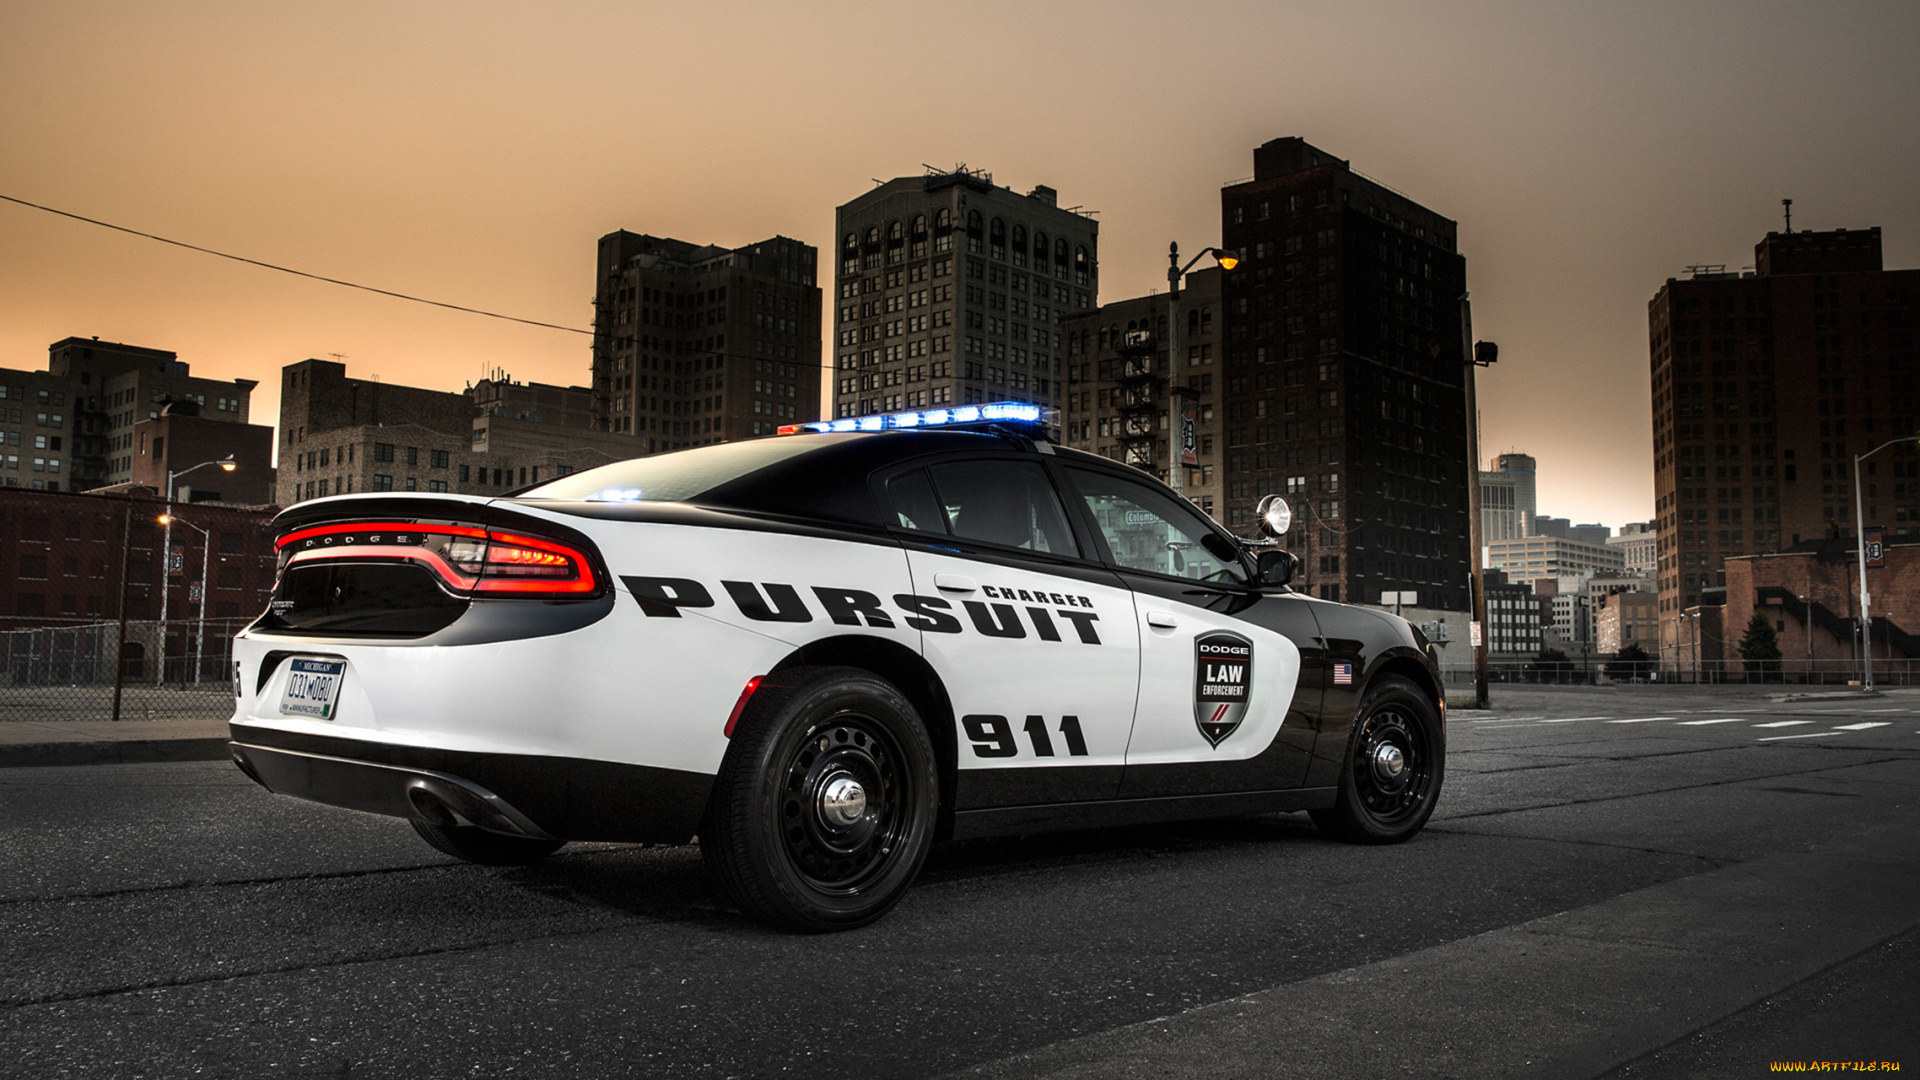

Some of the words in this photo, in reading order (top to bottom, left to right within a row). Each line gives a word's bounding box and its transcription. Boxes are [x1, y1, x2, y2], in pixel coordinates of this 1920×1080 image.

[306, 535, 408, 546] DODGE
[981, 585, 1094, 609] CHARGER
[618, 575, 1102, 645] PURSUIT
[1200, 645, 1249, 655] DODGE
[303, 661, 331, 672] MICHIGAN
[1206, 664, 1243, 683] LAW
[1203, 684, 1244, 696] ENFORCEMENT
[962, 714, 1089, 758] 911
